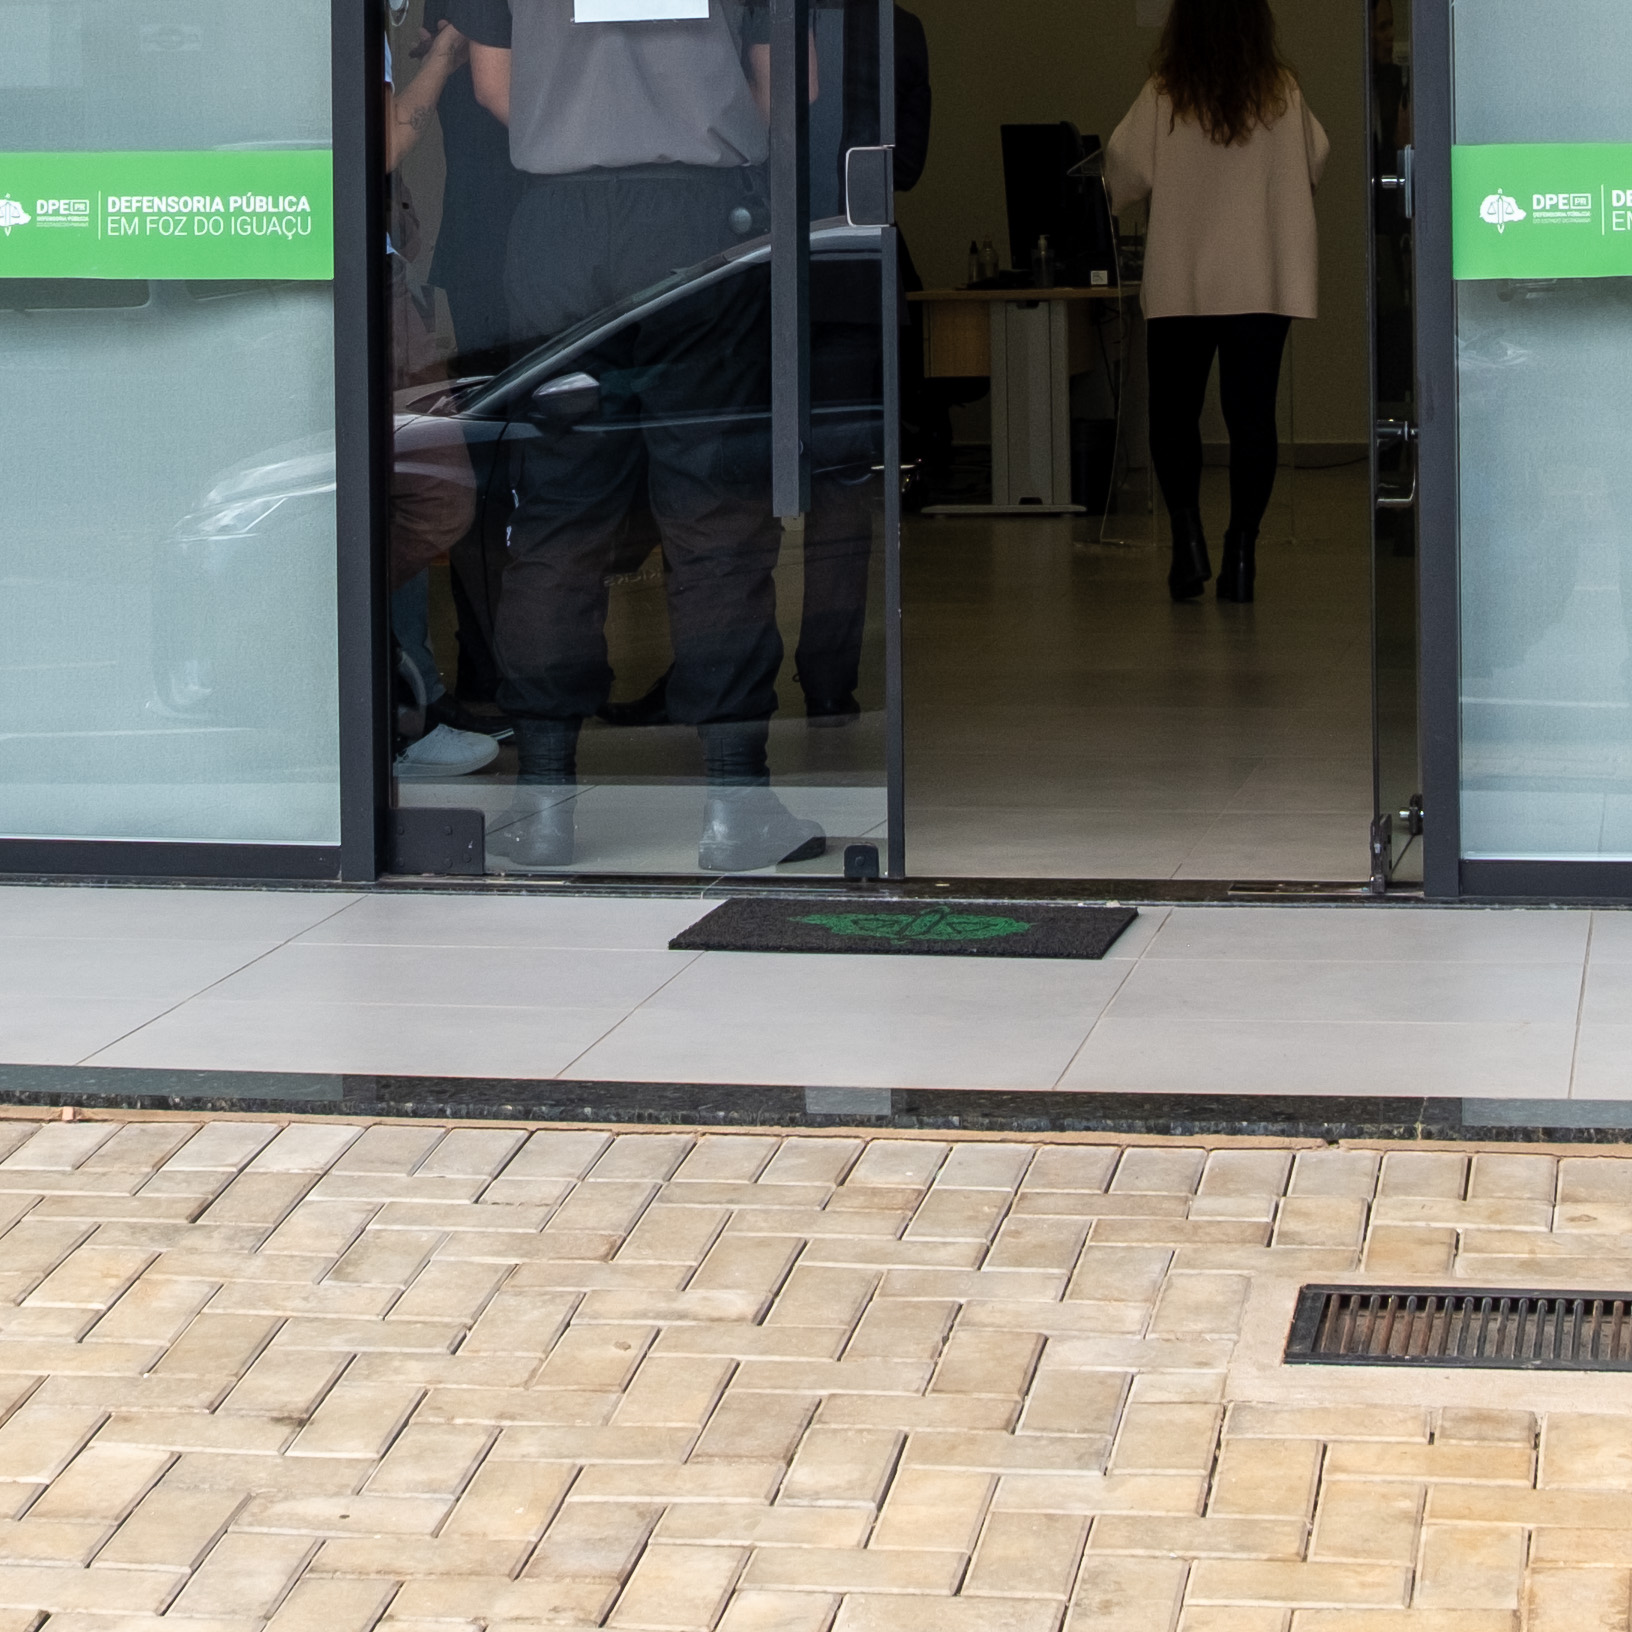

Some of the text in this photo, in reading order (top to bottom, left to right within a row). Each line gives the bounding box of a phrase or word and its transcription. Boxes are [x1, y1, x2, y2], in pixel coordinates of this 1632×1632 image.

[36, 200, 69, 215] DPE
[107, 192, 311, 213] DEFENSORIA PÚBLICA
[1532, 194, 1570, 210] DPE
[107, 216, 139, 236] EM
[146, 216, 187, 235] FOZ
[193, 216, 224, 235] DO
[231, 215, 312, 240] IGUAÇU
